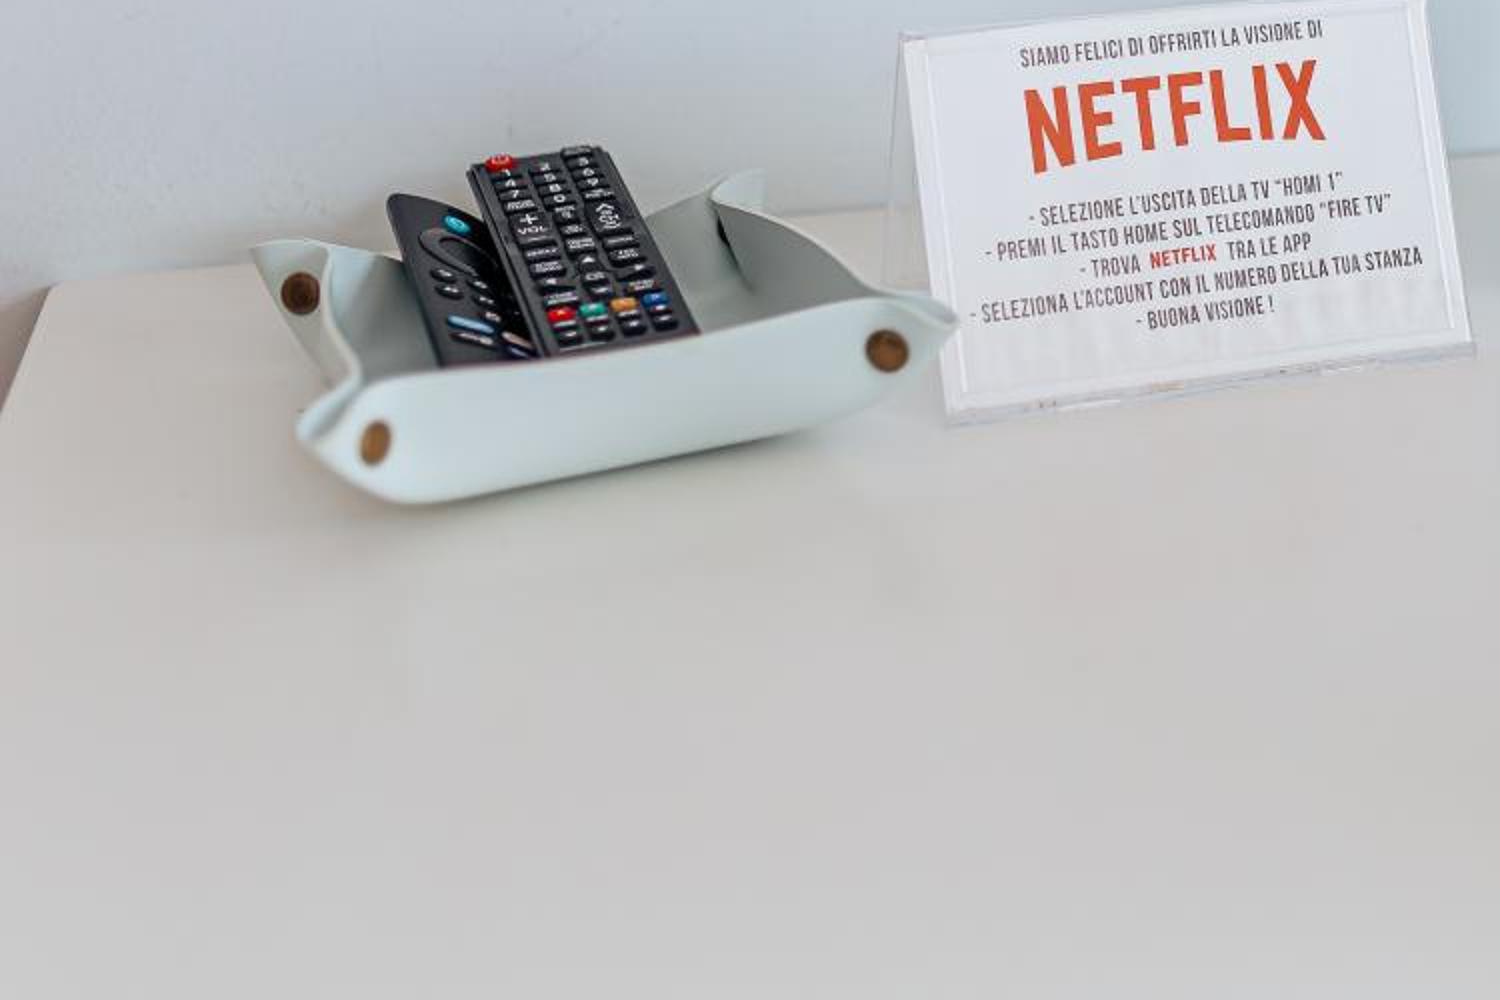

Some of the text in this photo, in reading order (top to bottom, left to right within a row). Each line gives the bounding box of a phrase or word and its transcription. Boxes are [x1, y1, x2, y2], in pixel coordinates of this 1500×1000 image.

[1020, 19, 1323, 67] SIAMO FELICI DI OFFRIRTI LA VISIONE DI
[1023, 59, 1326, 174] NETFLIX
[1039, 197, 1124, 226] SELEZIONE
[1129, 189, 1196, 215] L'USCITA
[1200, 185, 1247, 207] DELLA
[1251, 179, 1269, 200] TV
[518, 225, 549, 235] VOL
[997, 237, 1046, 261] PREMI
[1052, 237, 1066, 255] IL
[1070, 228, 1118, 251] TASTO
[1123, 221, 1168, 245] HOME
[1172, 217, 1202, 239] SUL
[1206, 203, 1315, 233] TELECOMANDO
[1091, 254, 1140, 278] TROVA
[1149, 243, 1216, 269] NETFLIX
[1227, 239, 1256, 261] TRA
[1260, 236, 1277, 257] LE
[1283, 232, 1311, 253] APP
[981, 293, 1069, 323] SELEZIONA
[1073, 281, 1153, 310] L'ACCOUNT
[1159, 275, 1192, 299] CON
[1197, 274, 1210, 294] IL
[1214, 265, 1277, 291] NUMERO
[1281, 258, 1329, 283] DELLA
[1332, 253, 1361, 275] TUA
[1365, 247, 1423, 271] STANZA
[1147, 305, 1200, 329] BUONA
[1204, 297, 1264, 321] VISIONE
